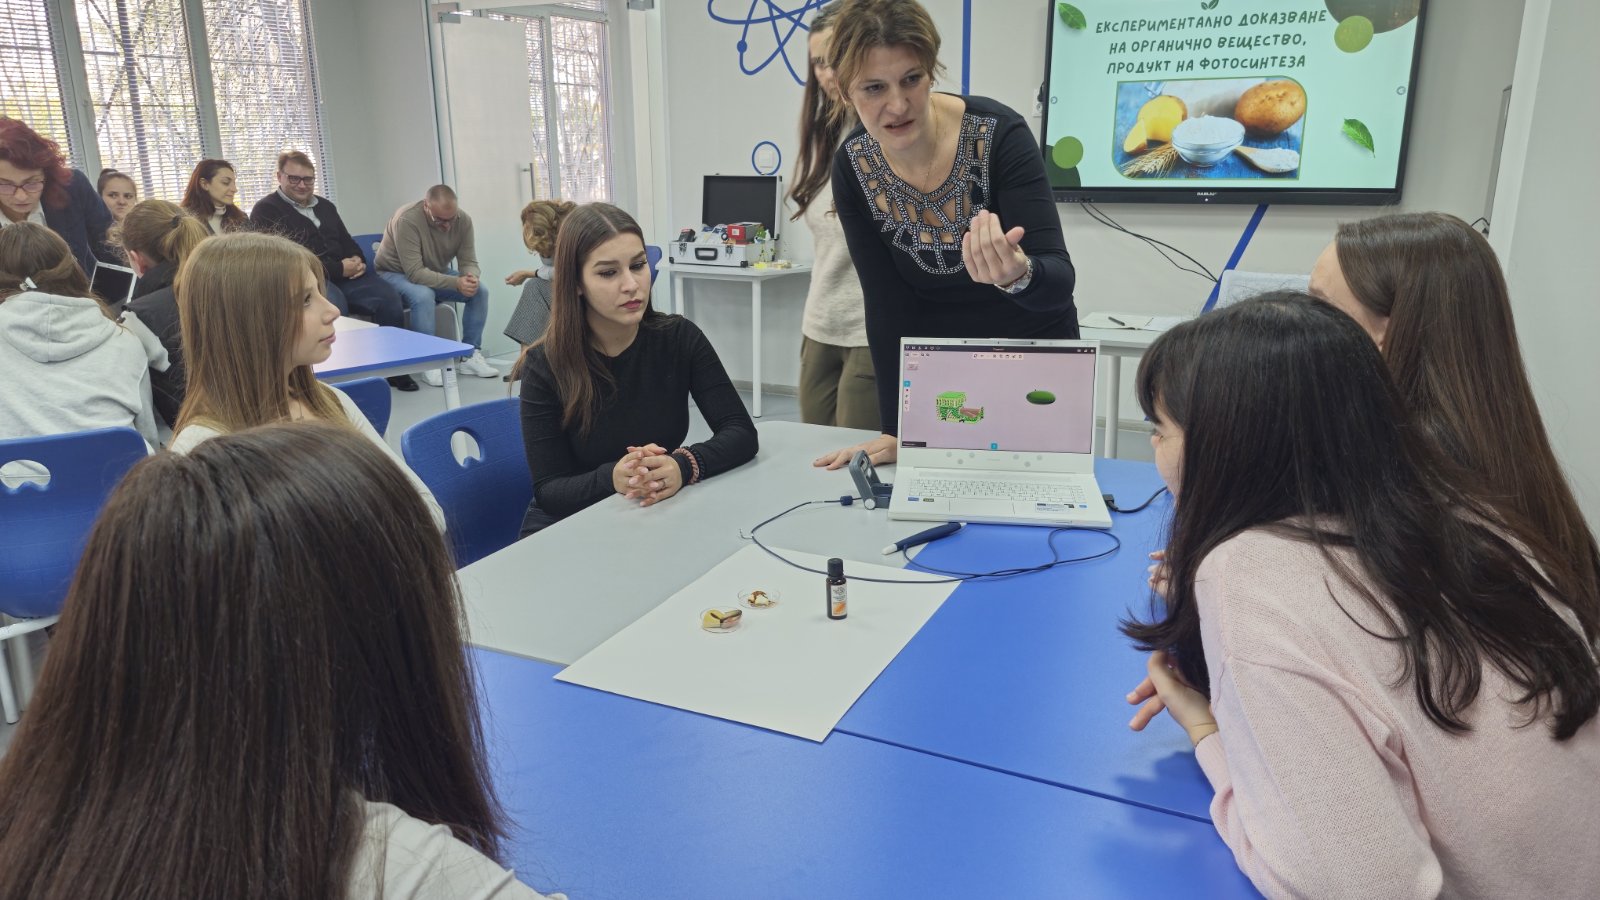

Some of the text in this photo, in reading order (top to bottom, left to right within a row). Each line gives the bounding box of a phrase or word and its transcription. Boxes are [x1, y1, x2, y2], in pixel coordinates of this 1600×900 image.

[1096, 10, 1327, 33] ЕКСПЕРИМЕНТАЛНО ДОКАЗВАНЕ
[1109, 33, 1306, 55] НА ОРГАНИЧНО ВЕЩЕСТВО,
[1106, 55, 1306, 74] ПРОДУКТ НА ФОТОСИНТЕЗА
